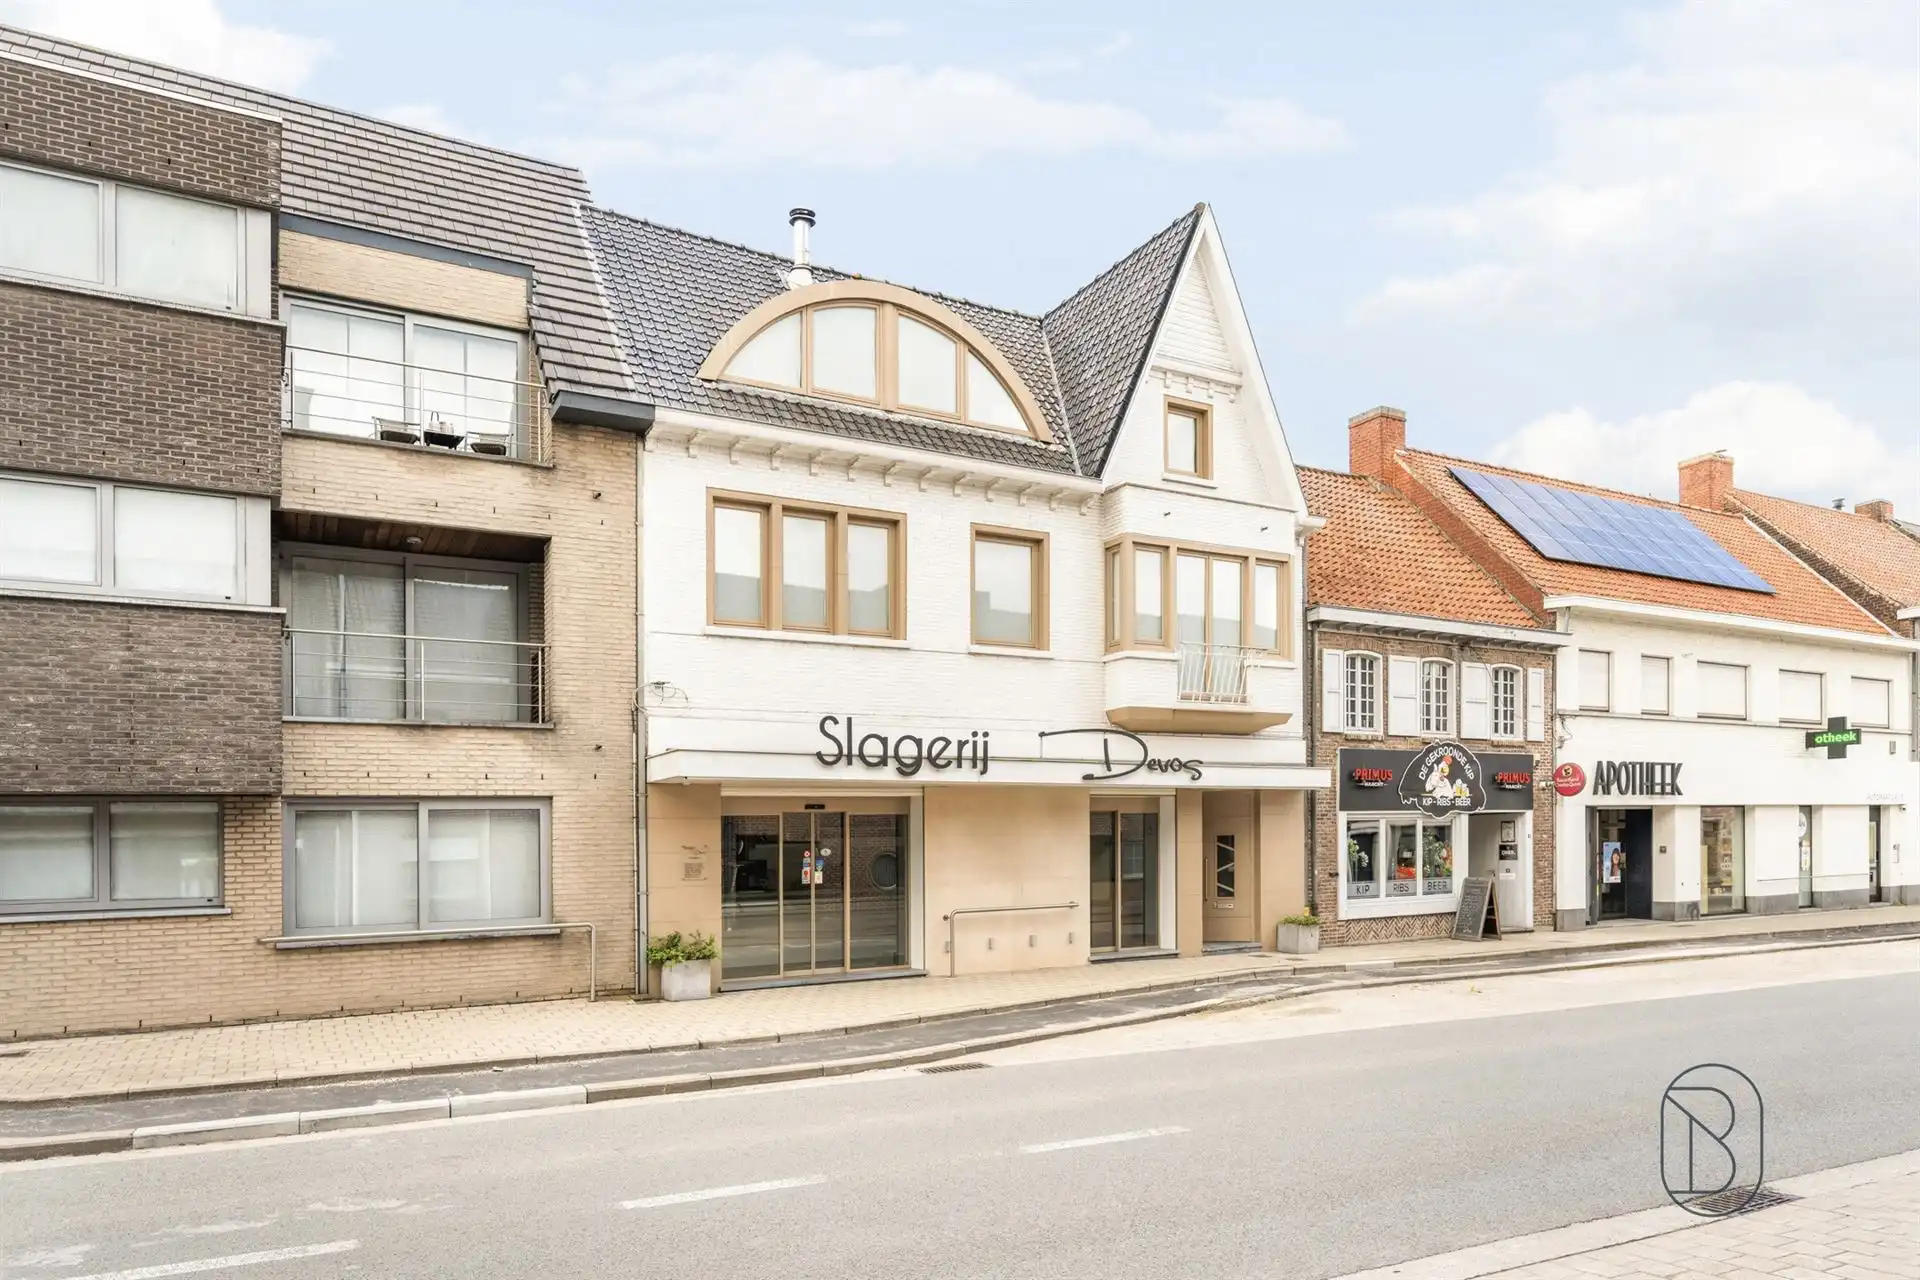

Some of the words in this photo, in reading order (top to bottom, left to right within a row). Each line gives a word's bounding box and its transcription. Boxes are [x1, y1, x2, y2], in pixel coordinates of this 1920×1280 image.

[1814, 731, 1857, 743] otheek
[816, 715, 990, 777] Slagerij
[1038, 728, 1204, 780] Devos
[1418, 764, 1429, 780] DE
[1425, 746, 1468, 766] GEKROONDE
[1463, 762, 1475, 780] KIP
[1354, 768, 1393, 781] PRIMUS
[1496, 772, 1531, 784] PRIMUS
[1592, 760, 1684, 796] APOTHEEK
[1422, 797, 1433, 806] KIP
[1436, 797, 1451, 806] RIBS
[1455, 797, 1472, 806] BEER
[1356, 884, 1370, 895] KIP
[1393, 883, 1410, 893] RIBS
[1427, 881, 1448, 891] BEER
